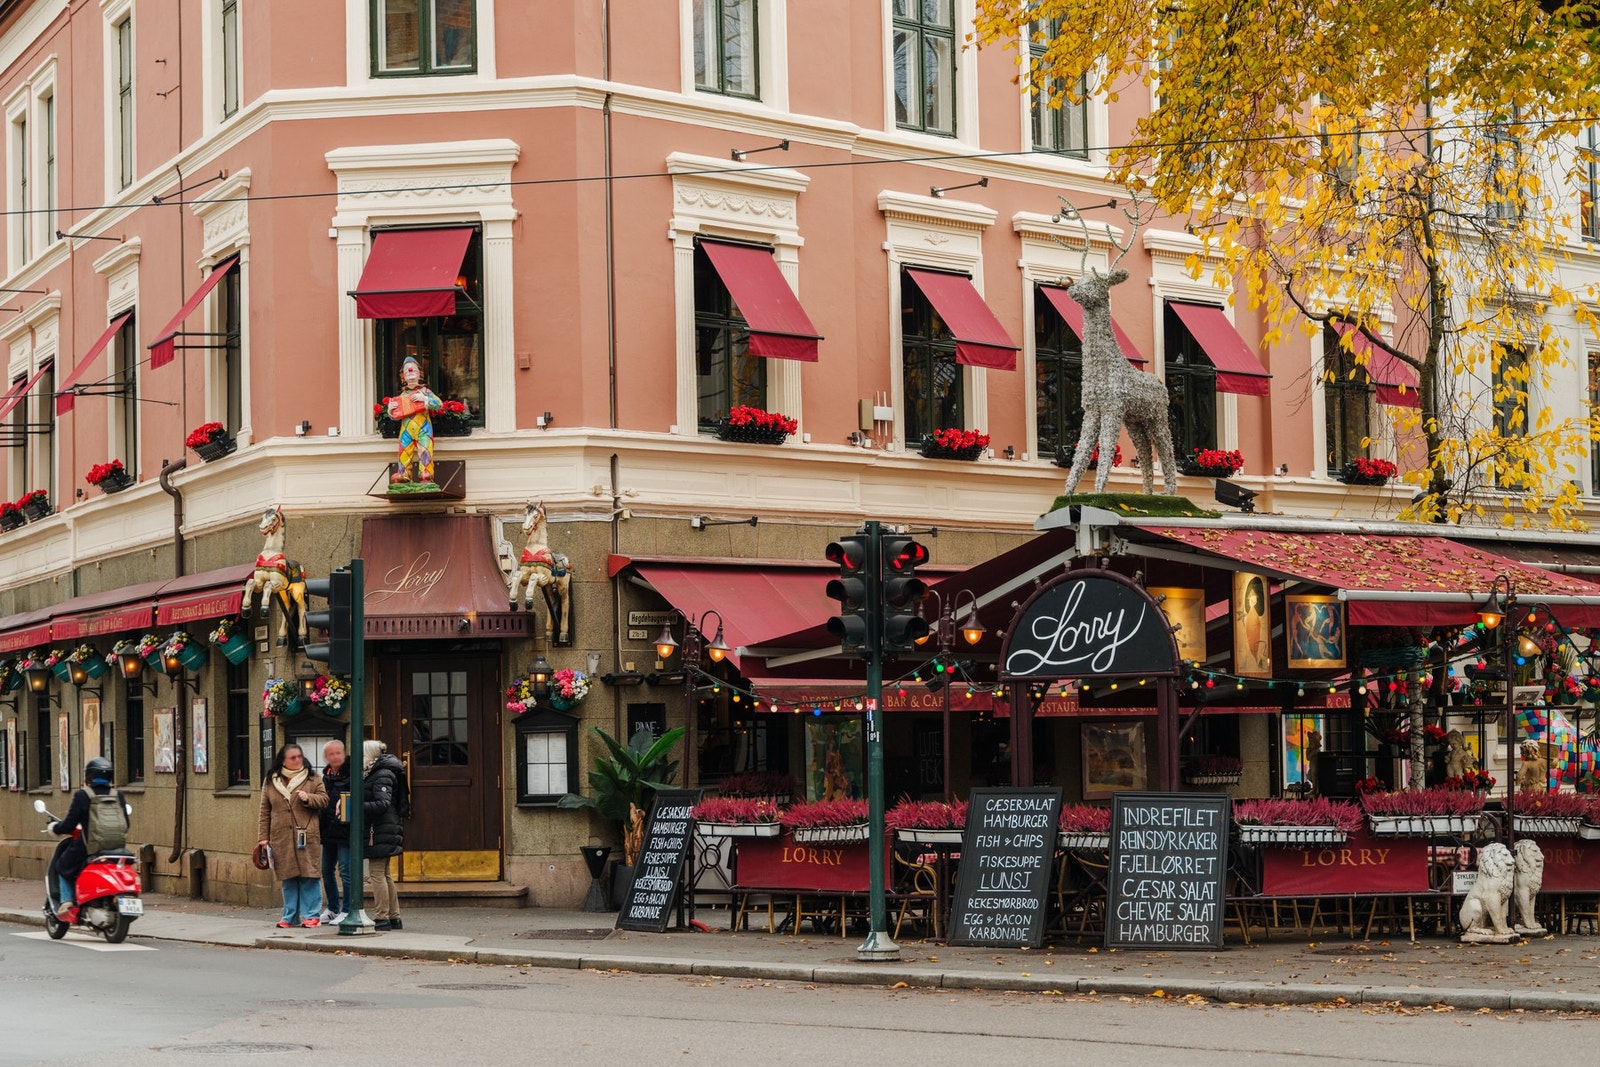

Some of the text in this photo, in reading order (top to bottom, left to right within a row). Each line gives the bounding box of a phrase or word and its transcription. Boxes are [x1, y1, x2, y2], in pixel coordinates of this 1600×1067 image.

[363, 551, 450, 605] Lorry
[1006, 580, 1146, 675] Lorry
[887, 696, 906, 707] BAR
[910, 695, 920, 708] &
[922, 694, 944, 707] CAF
[1037, 701, 1094, 712] ESTAUR
[986, 798, 1055, 812] CÆSERSALAT
[984, 814, 1048, 828] HAMBURGER
[1124, 807, 1218, 827] INDREFILET
[652, 822, 688, 835] HAMBURGER
[650, 838, 664, 850] FISH
[667, 838, 684, 850] CHIPS
[976, 835, 1000, 848] FISH
[1012, 834, 1044, 848] CHIPS
[1120, 830, 1218, 850] REINSDYRKAKER
[643, 852, 680, 864] FISKESUPPE
[782, 846, 846, 866] LORRY
[980, 855, 1042, 868] FISKESUPPE
[1302, 848, 1391, 868] LORRY
[1544, 848, 1585, 865] ORRY
[1120, 854, 1217, 875] FJELLØRRET
[980, 871, 1032, 890] LUNSJ
[1122, 878, 1218, 900] CÆSAR SALAT
[633, 892, 646, 904] EGG
[648, 892, 668, 906] BACON
[968, 898, 1038, 910] REKESMØRBRØD
[628, 906, 662, 920] KARBONADE
[964, 913, 983, 925] EGG
[995, 914, 1032, 925] BACON
[1117, 902, 1218, 922] CHEVRE SALAT
[968, 926, 1030, 942] KARBONADE
[1120, 924, 1210, 943] HAMBURGER
